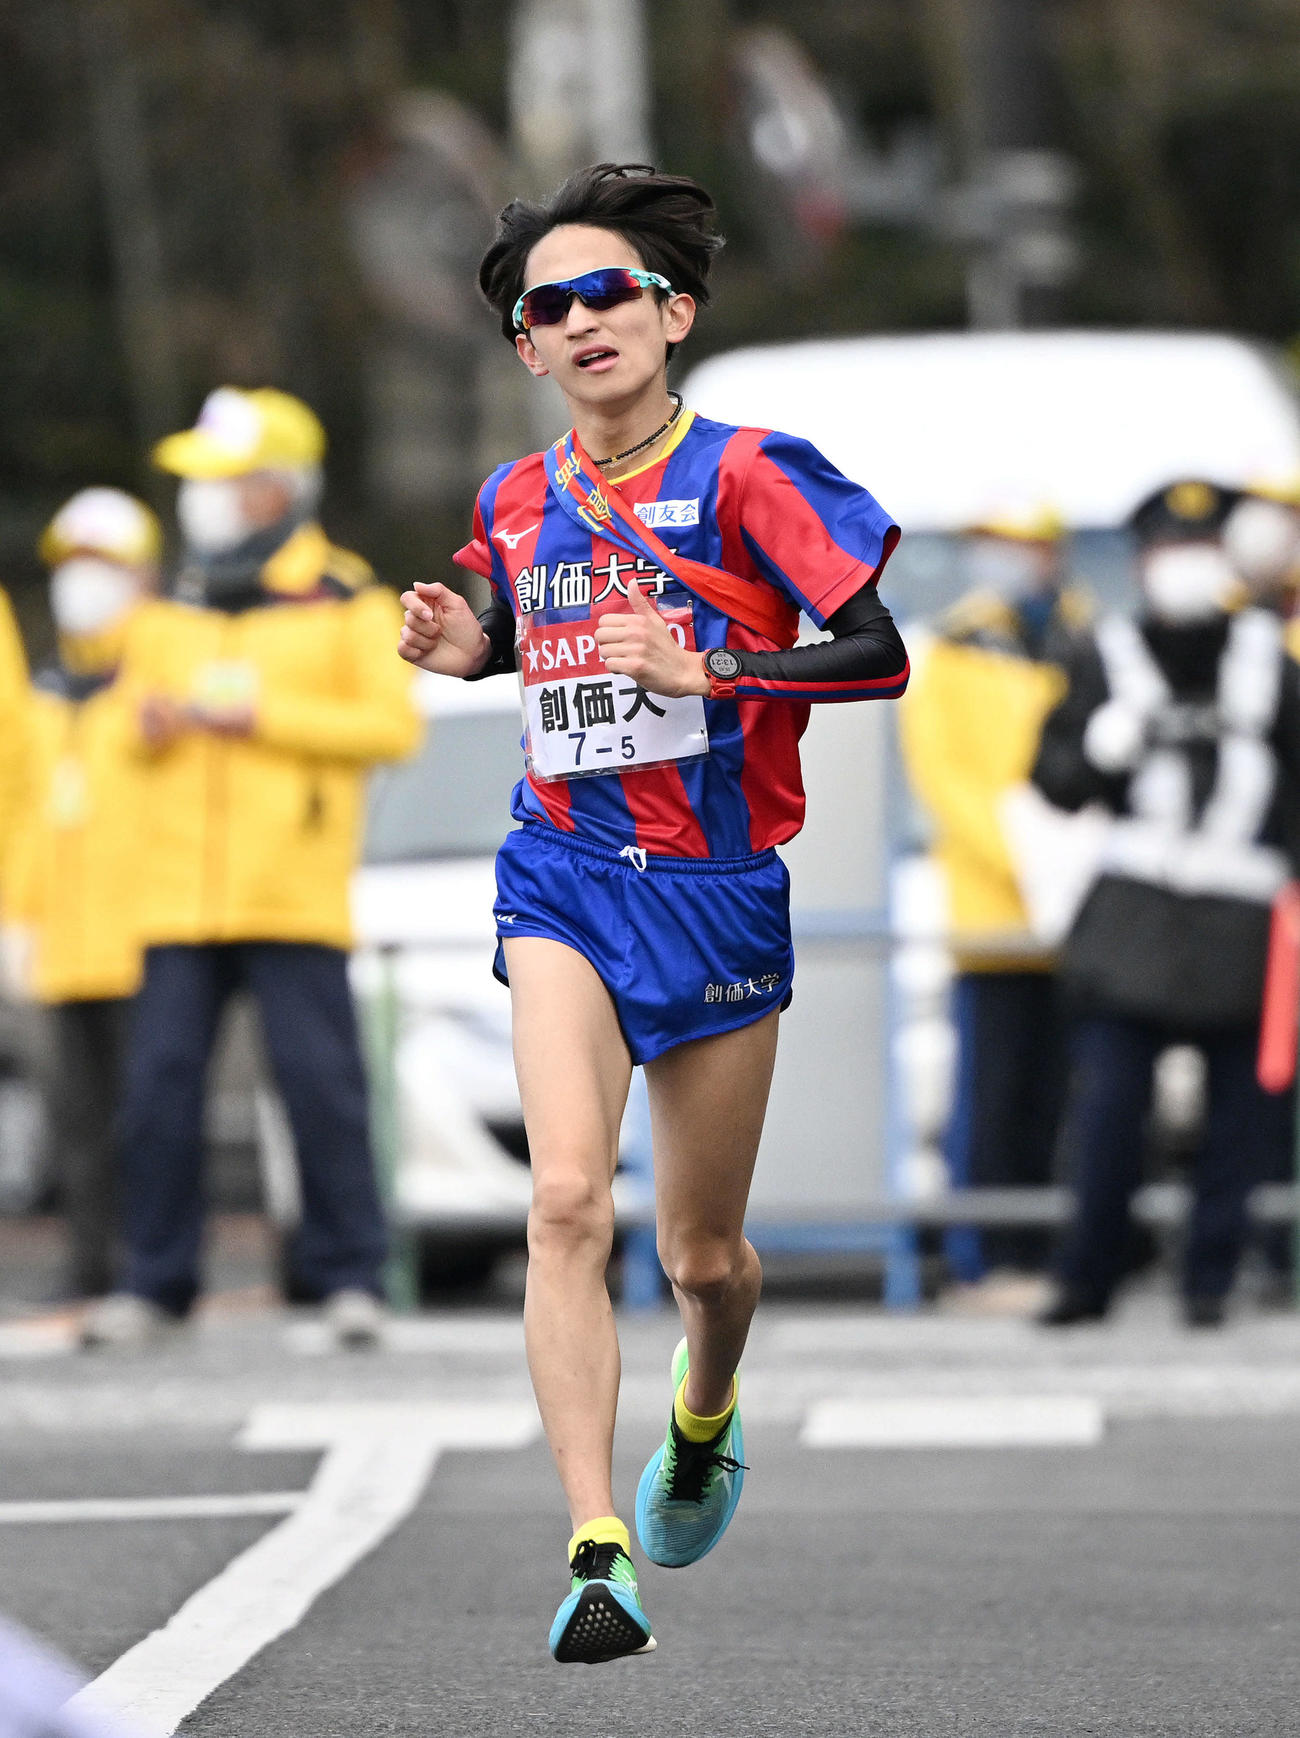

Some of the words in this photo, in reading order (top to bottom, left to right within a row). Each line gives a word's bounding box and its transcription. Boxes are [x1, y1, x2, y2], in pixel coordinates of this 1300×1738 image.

[552, 429, 613, 532] 創価
[637, 503, 696, 524] 創友会
[539, 681, 666, 733] 創価大
[703, 972, 780, 1003] 創価大学
